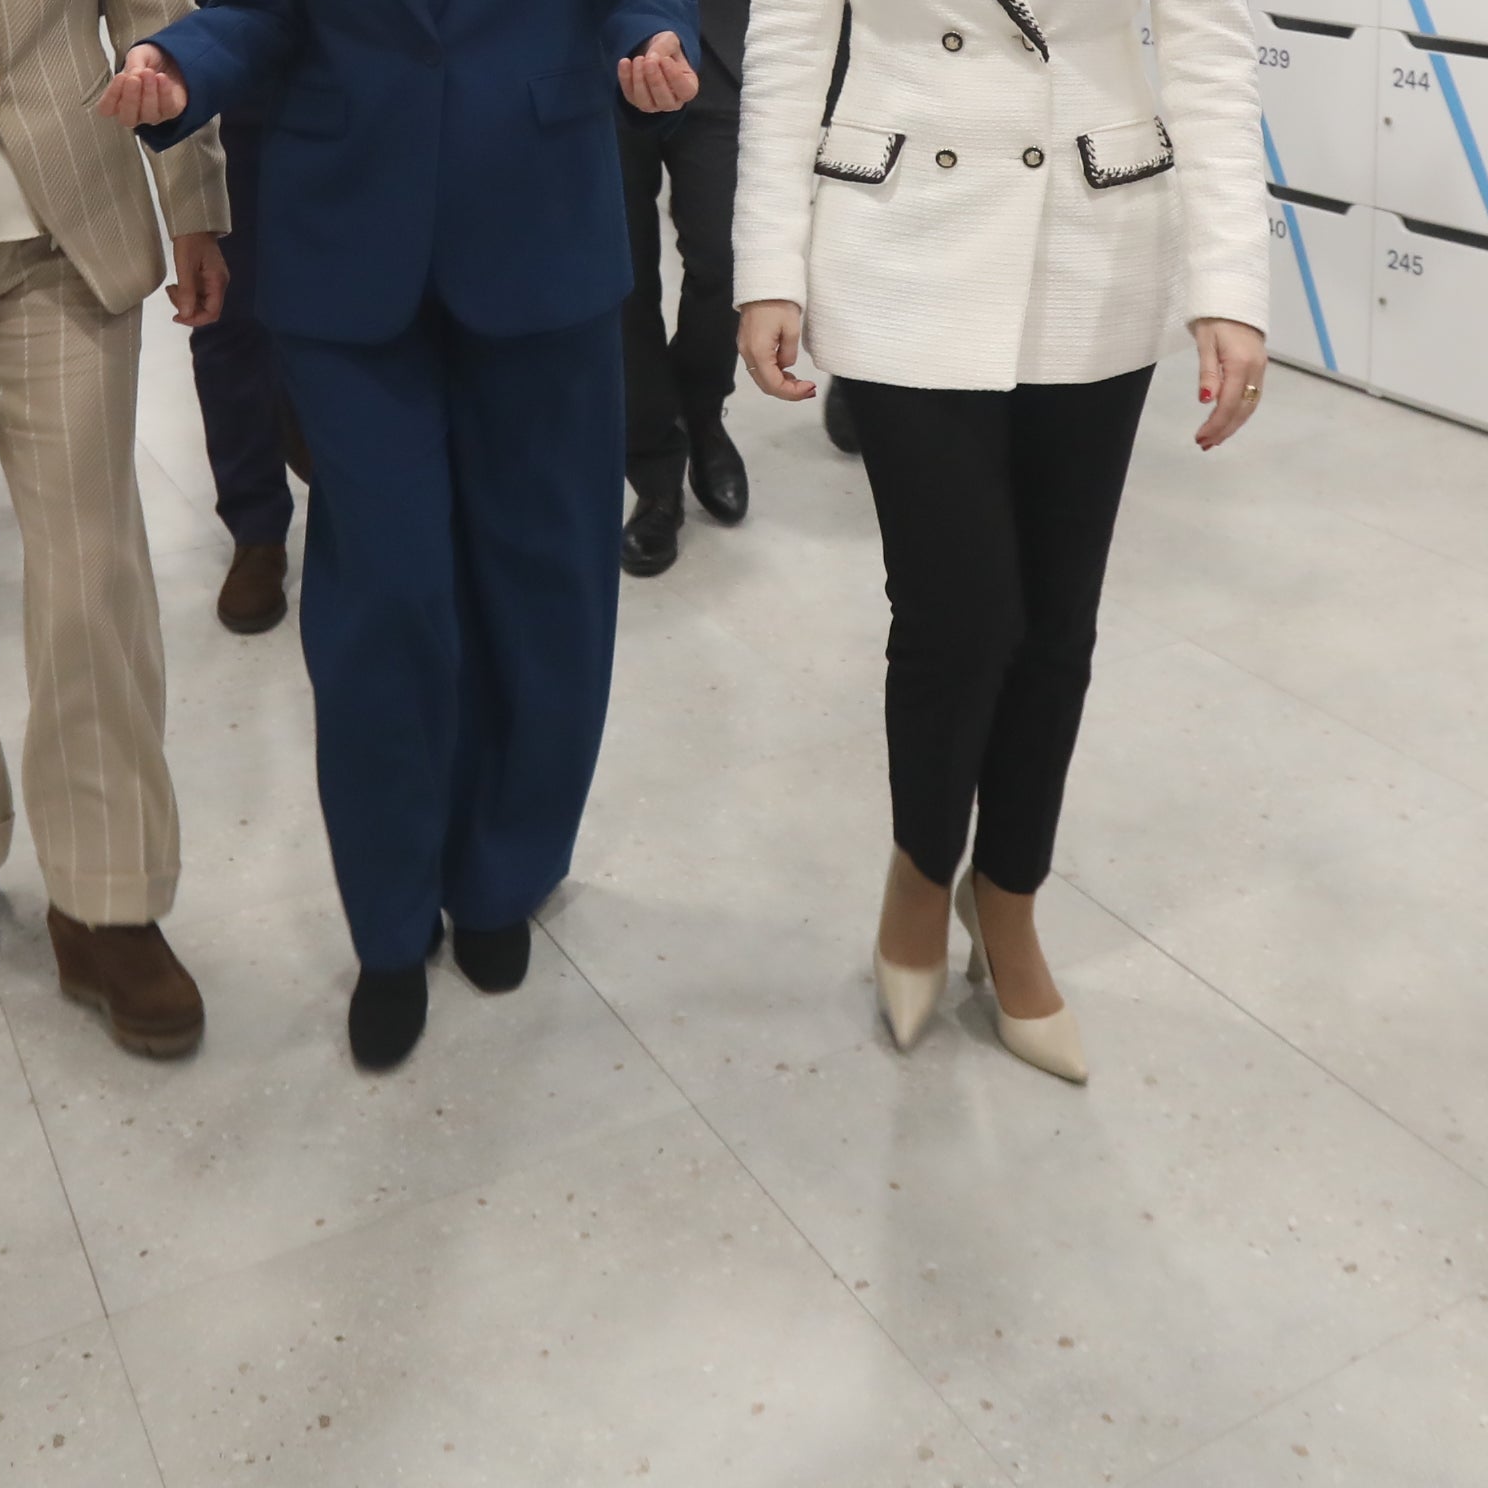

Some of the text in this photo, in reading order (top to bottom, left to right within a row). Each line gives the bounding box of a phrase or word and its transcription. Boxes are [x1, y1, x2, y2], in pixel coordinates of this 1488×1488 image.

[1257, 46, 1290, 69] 239
[1392, 67, 1431, 92] 244
[1387, 249, 1424, 276] 245
